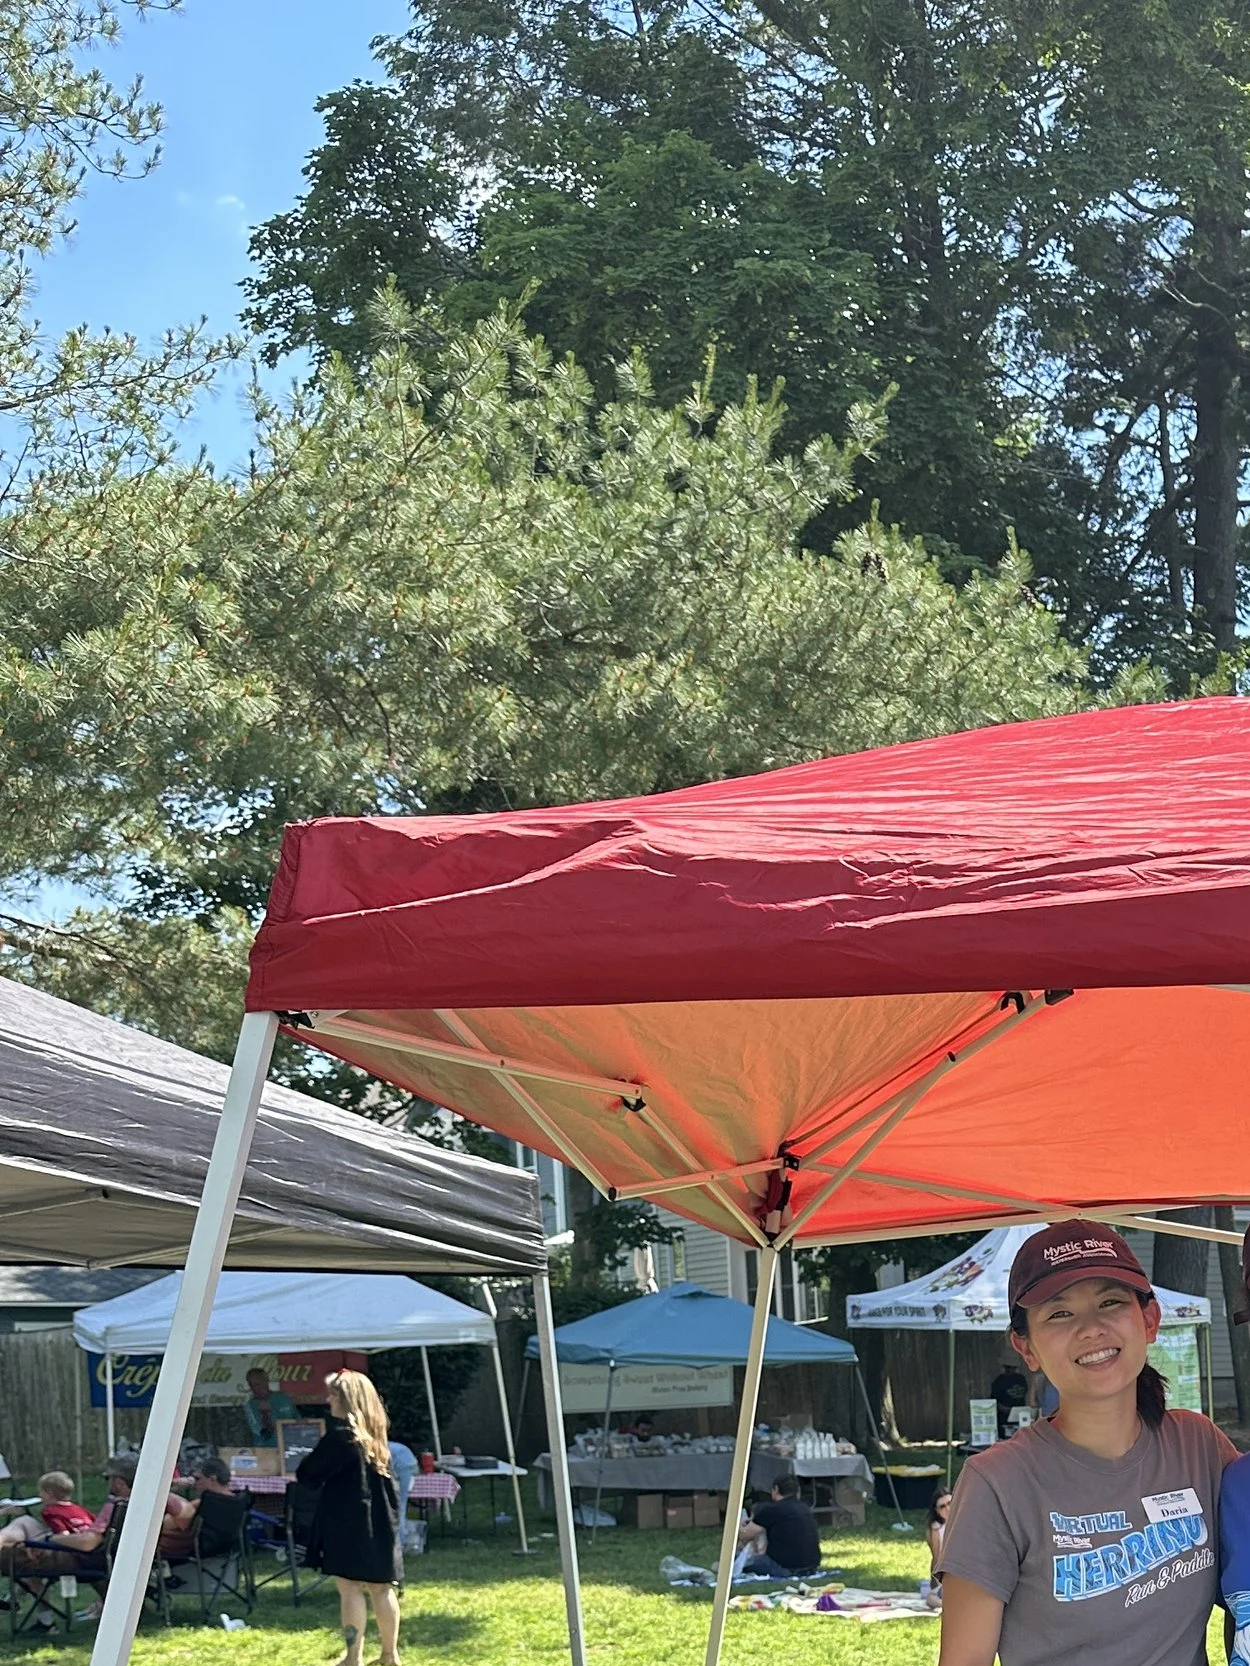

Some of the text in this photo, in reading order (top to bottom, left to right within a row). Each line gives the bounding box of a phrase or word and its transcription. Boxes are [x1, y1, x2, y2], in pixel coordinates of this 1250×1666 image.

[1043, 1238, 1113, 1259] Mystic River
[1161, 1505, 1189, 1518] Daria
[1125, 1548, 1215, 1608] Run & Paddle
